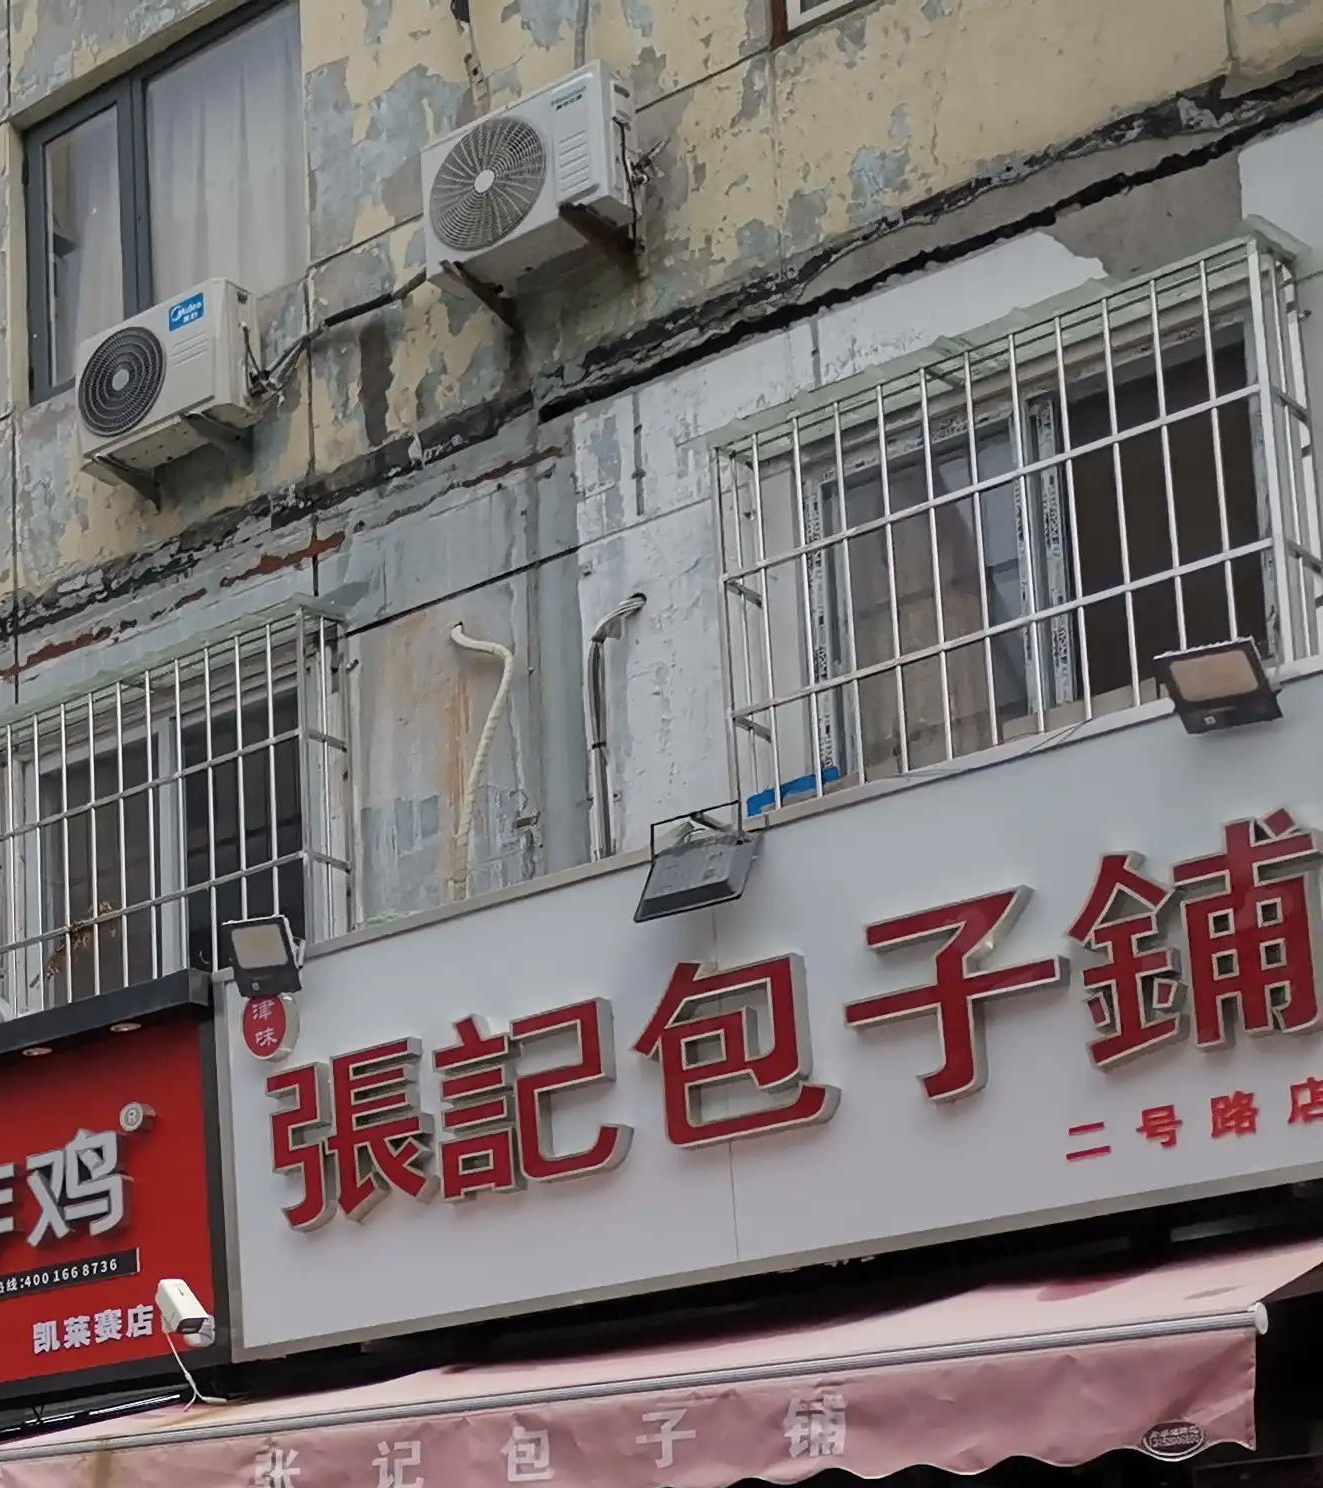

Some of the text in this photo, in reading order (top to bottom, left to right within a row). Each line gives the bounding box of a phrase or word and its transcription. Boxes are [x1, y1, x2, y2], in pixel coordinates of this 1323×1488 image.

[1066, 1077, 1323, 1161] 二号路店
[32, 1303, 155, 1355] 凯莱赛店
